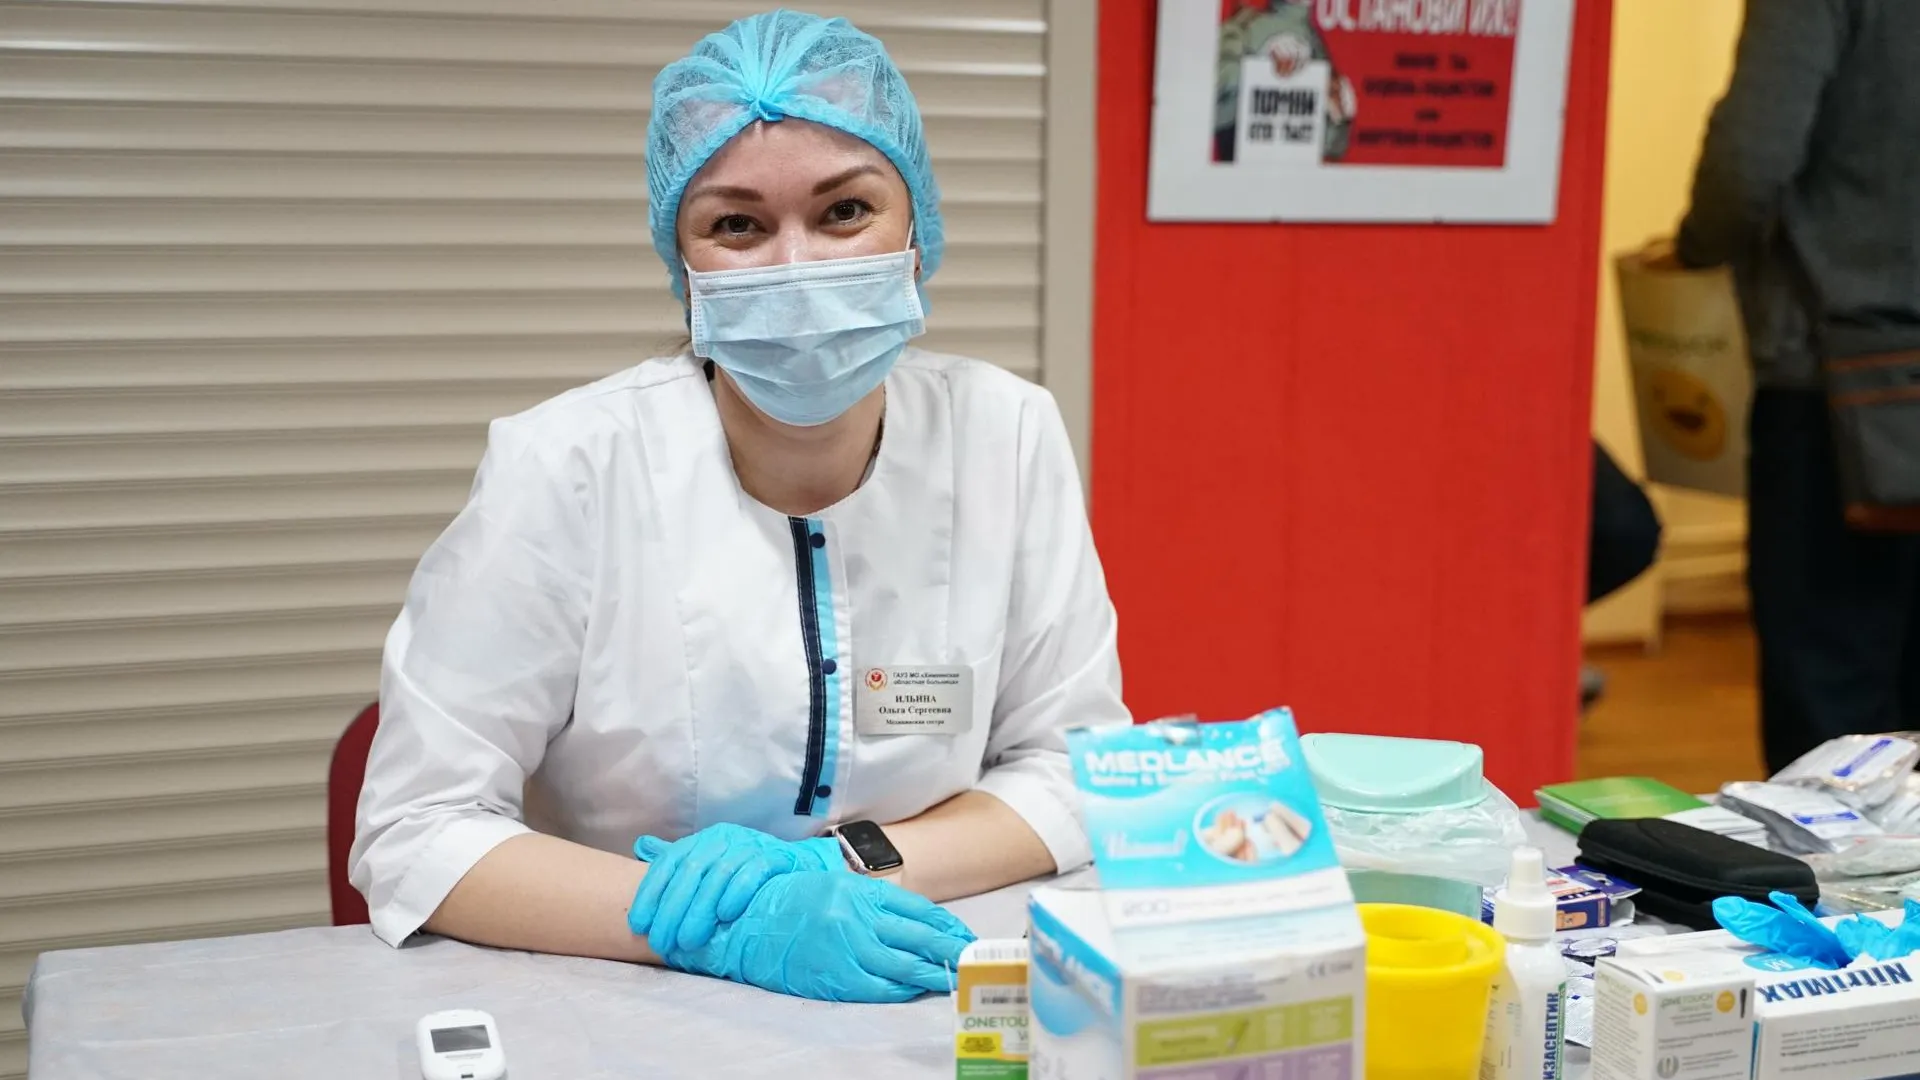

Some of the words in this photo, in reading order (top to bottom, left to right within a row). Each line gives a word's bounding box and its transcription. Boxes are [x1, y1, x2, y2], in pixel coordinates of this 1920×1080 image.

[1253, 89, 1317, 117] ПОМНИ
[879, 706, 906, 714] Ольга
[908, 706, 952, 716] Сергеевна
[895, 695, 937, 703] ИЛЬИНА
[1084, 740, 1289, 776] MEDLANCE
[1755, 962, 1913, 1003] NitriMAX
